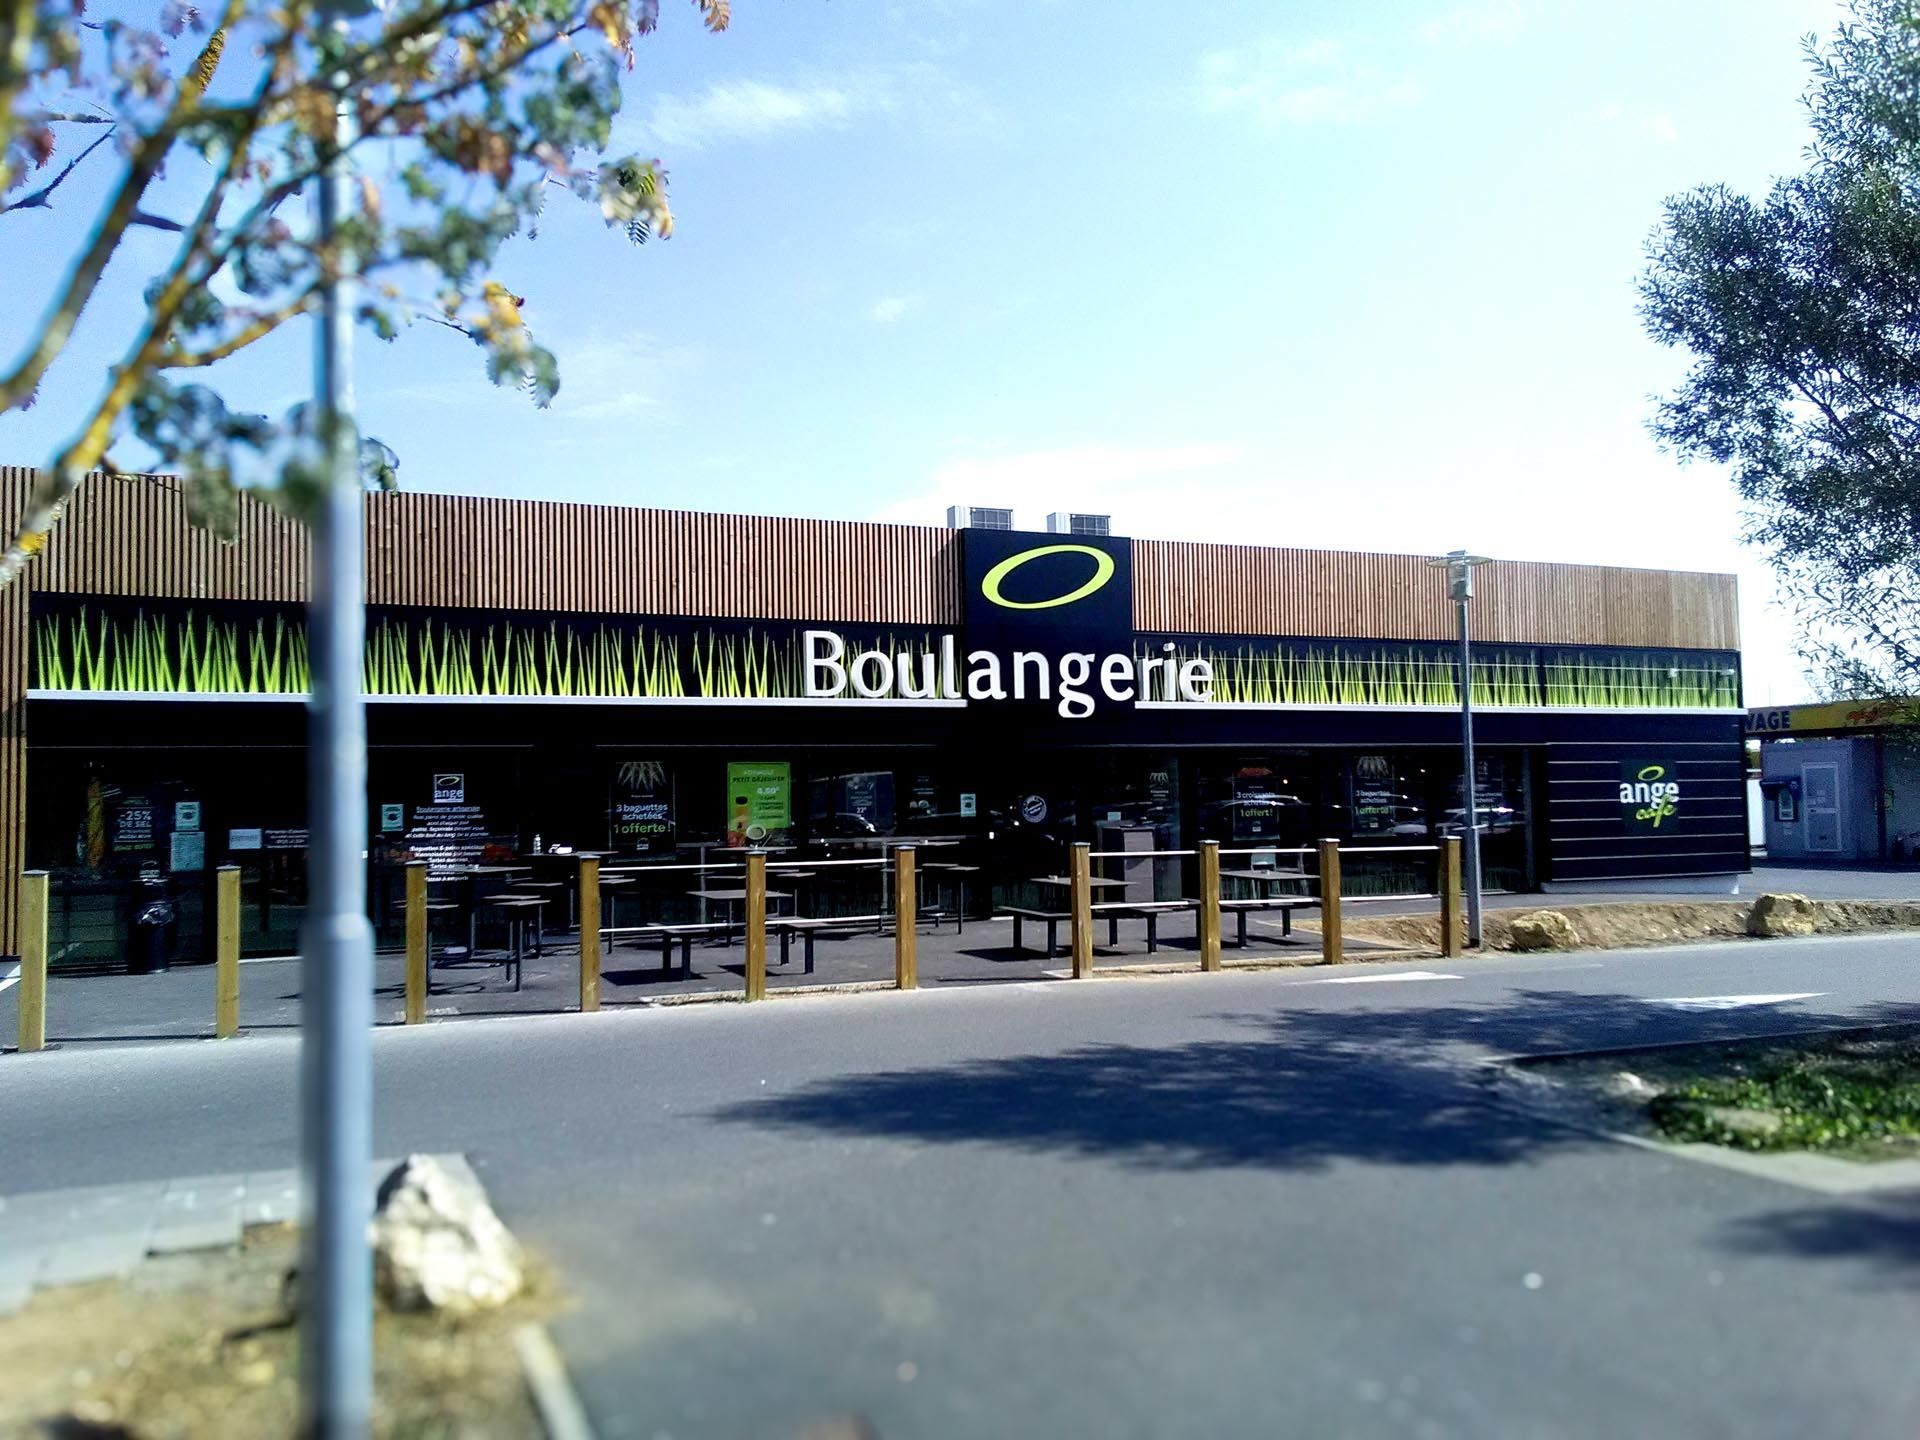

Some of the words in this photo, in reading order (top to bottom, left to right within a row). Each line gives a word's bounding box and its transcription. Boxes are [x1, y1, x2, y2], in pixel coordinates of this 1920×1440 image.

[803, 630, 1214, 718] Boulangerie
[434, 789, 464, 800] ange
[1619, 782, 1679, 809] ange
[616, 804, 622, 812] 3
[623, 804, 668, 813] baguettes
[120, 811, 152, 820] -25%
[622, 812, 662, 820] achetées
[614, 824, 619, 833] 1
